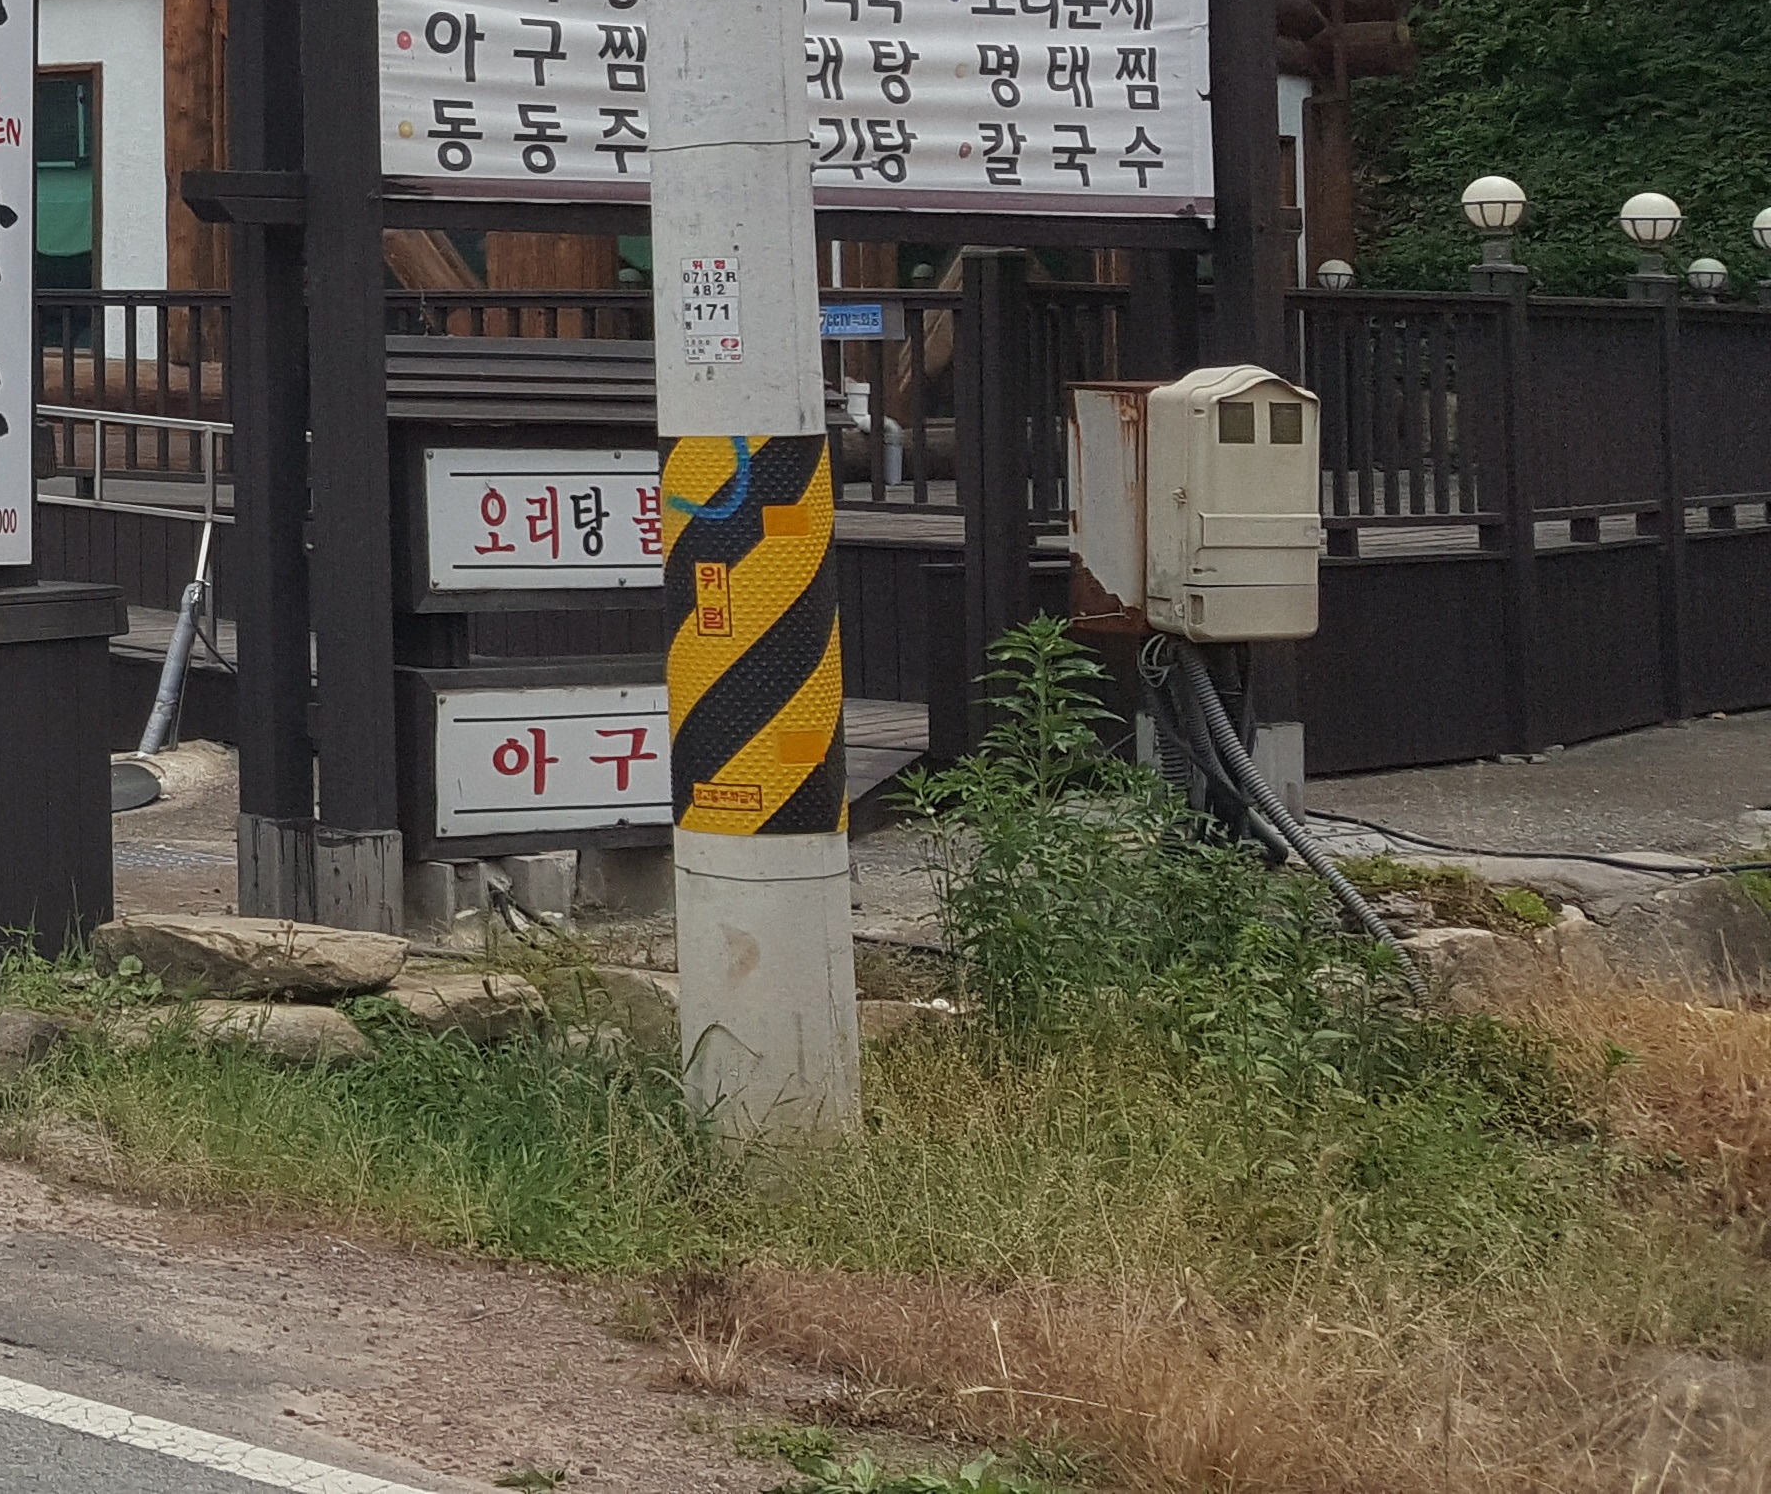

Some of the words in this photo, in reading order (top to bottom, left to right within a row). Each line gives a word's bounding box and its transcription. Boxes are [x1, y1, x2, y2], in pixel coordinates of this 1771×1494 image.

[424, 11, 647, 94] 아구찜
[977, 44, 1160, 111] 명태찜
[426, 99, 649, 175] 동동주
[810, 118, 918, 184] 기탕
[980, 122, 1164, 188] 칼국수
[683, 271, 737, 283] 0712R
[692, 284, 726, 296] 482
[693, 303, 730, 321] 171
[474, 486, 610, 560] 오리탕
[700, 566, 724, 630] 위험
